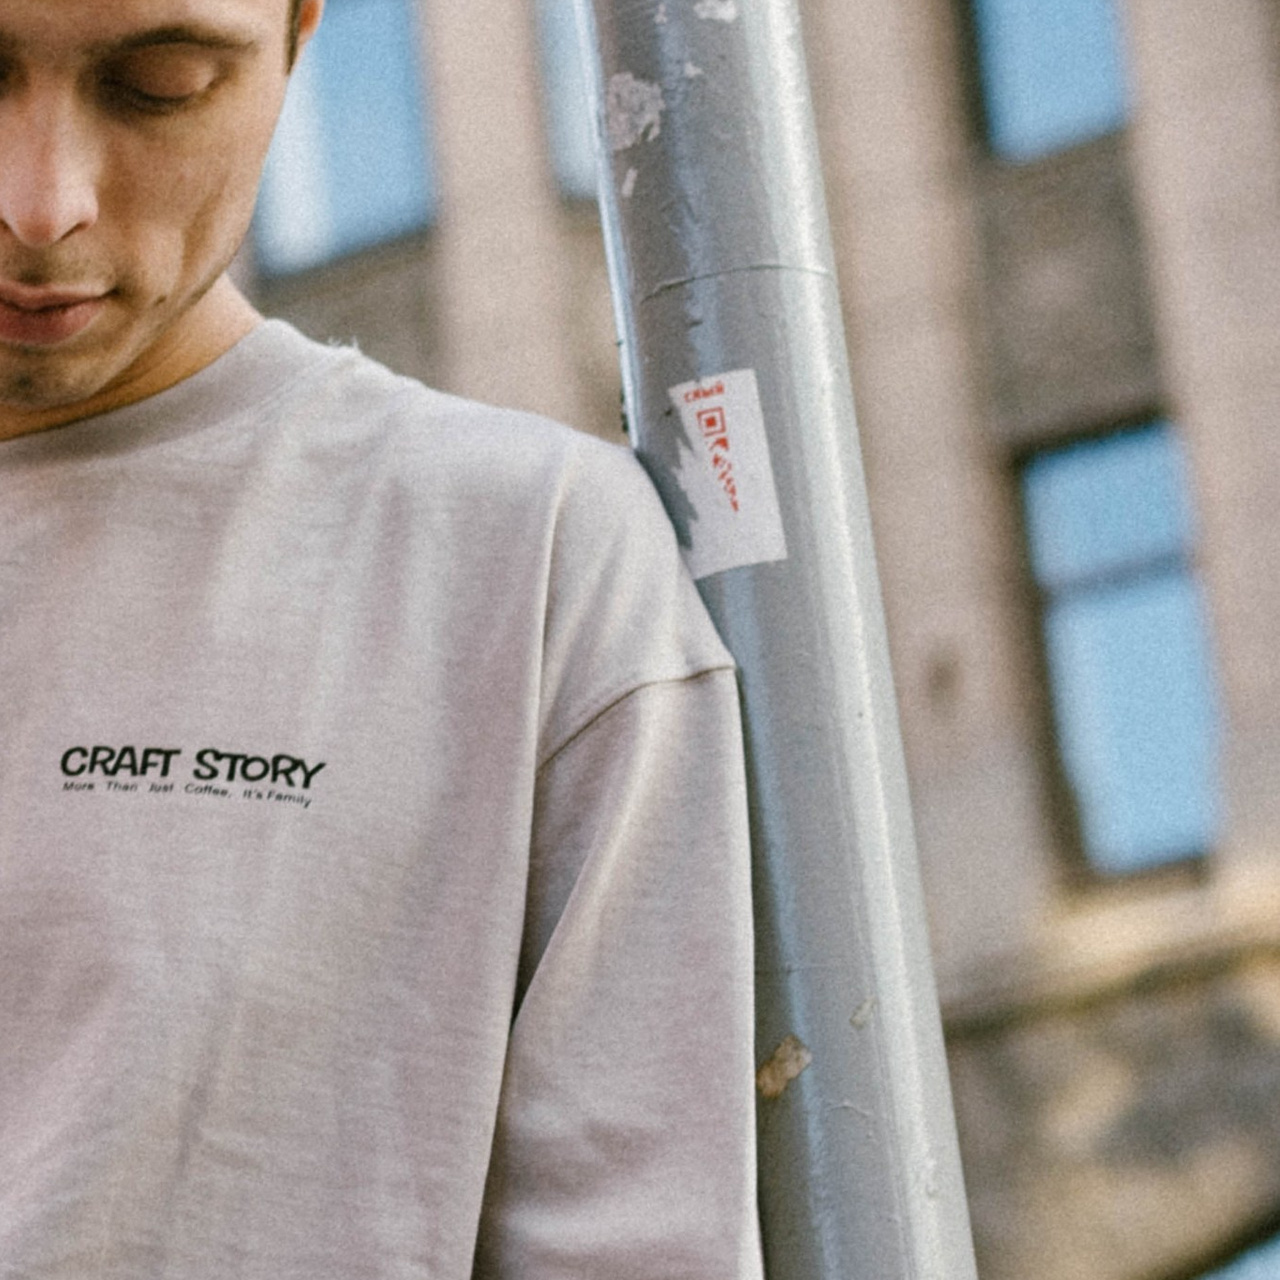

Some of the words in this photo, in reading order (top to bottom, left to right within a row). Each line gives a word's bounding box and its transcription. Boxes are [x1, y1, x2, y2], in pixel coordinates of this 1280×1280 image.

[60, 745, 182, 777] CRAFT
[193, 748, 326, 789] STORY
[62, 781, 95, 792] More
[107, 780, 138, 792] Than
[149, 782, 174, 793] Just
[267, 789, 312, 809] Family
